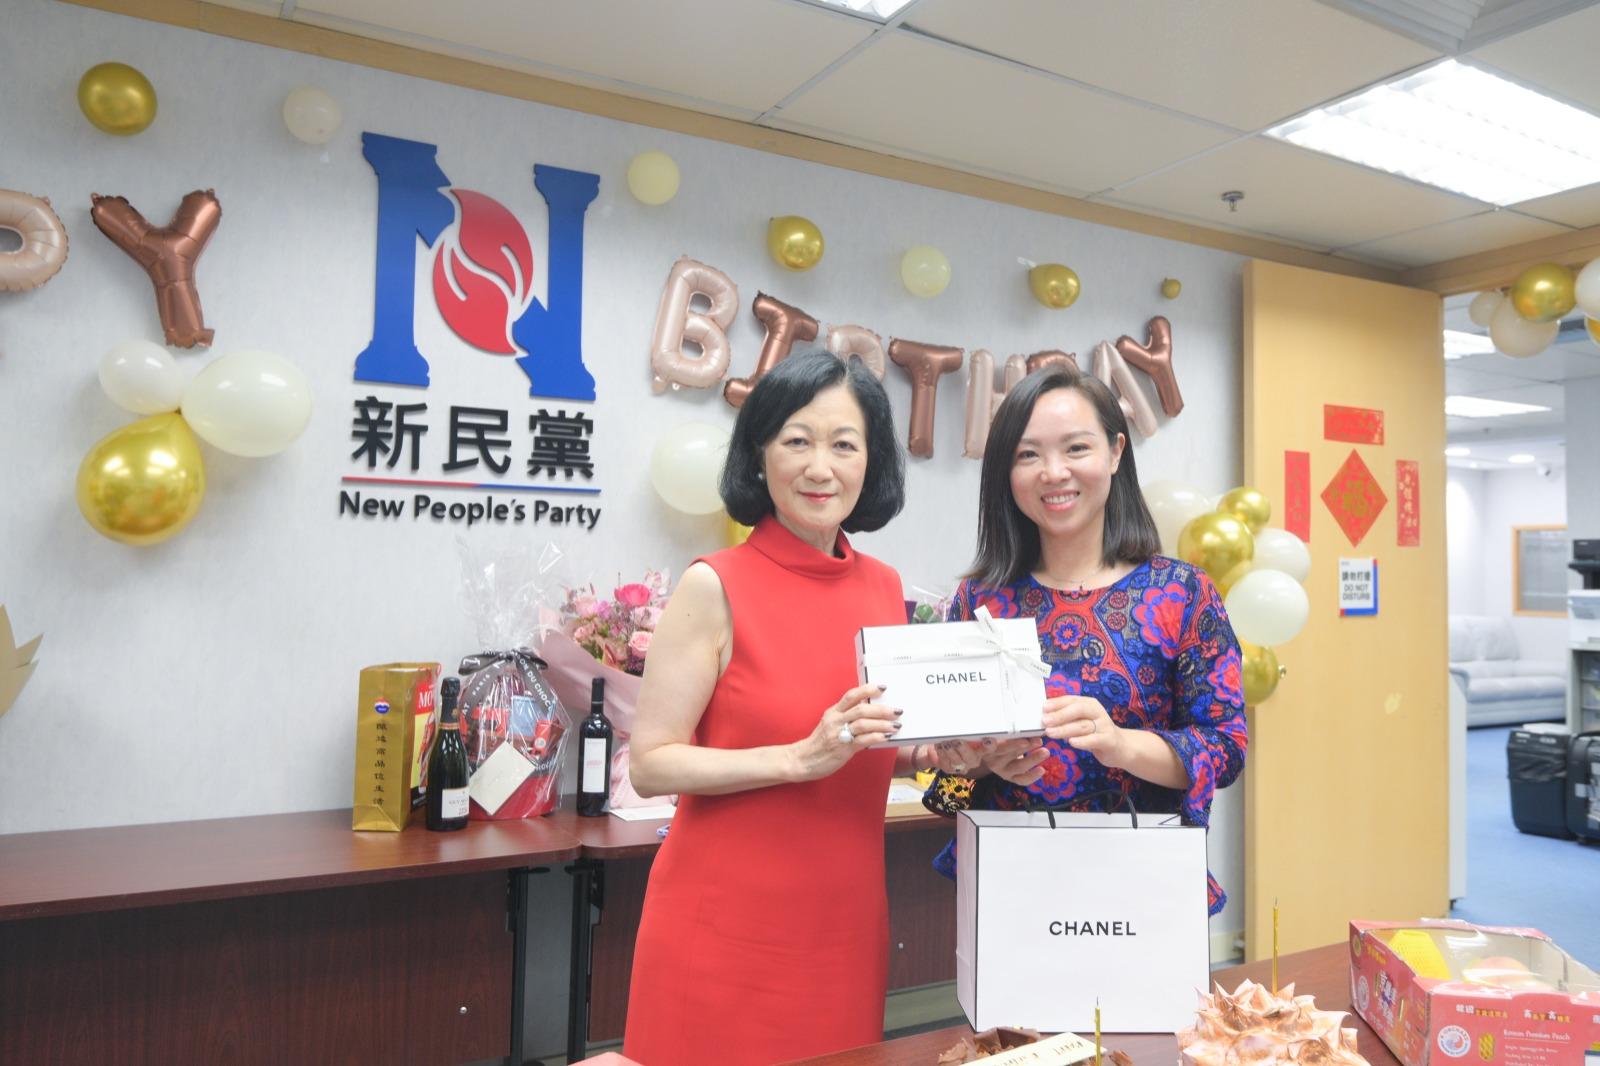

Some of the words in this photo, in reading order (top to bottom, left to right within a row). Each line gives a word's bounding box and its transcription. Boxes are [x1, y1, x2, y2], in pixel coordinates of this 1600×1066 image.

[652, 255, 1183, 458] BITHAY
[351, 395, 595, 479] 新民黨
[339, 490, 405, 517] New
[413, 494, 526, 527] People's
[534, 500, 602, 531] Party
[1342, 592, 1370, 601] DISTURB
[1344, 584, 1353, 592] DO
[1355, 584, 1368, 592] NOT
[925, 671, 987, 685] CHANEL
[418, 690, 433, 709] MO
[1049, 921, 1137, 936] CHANEL
